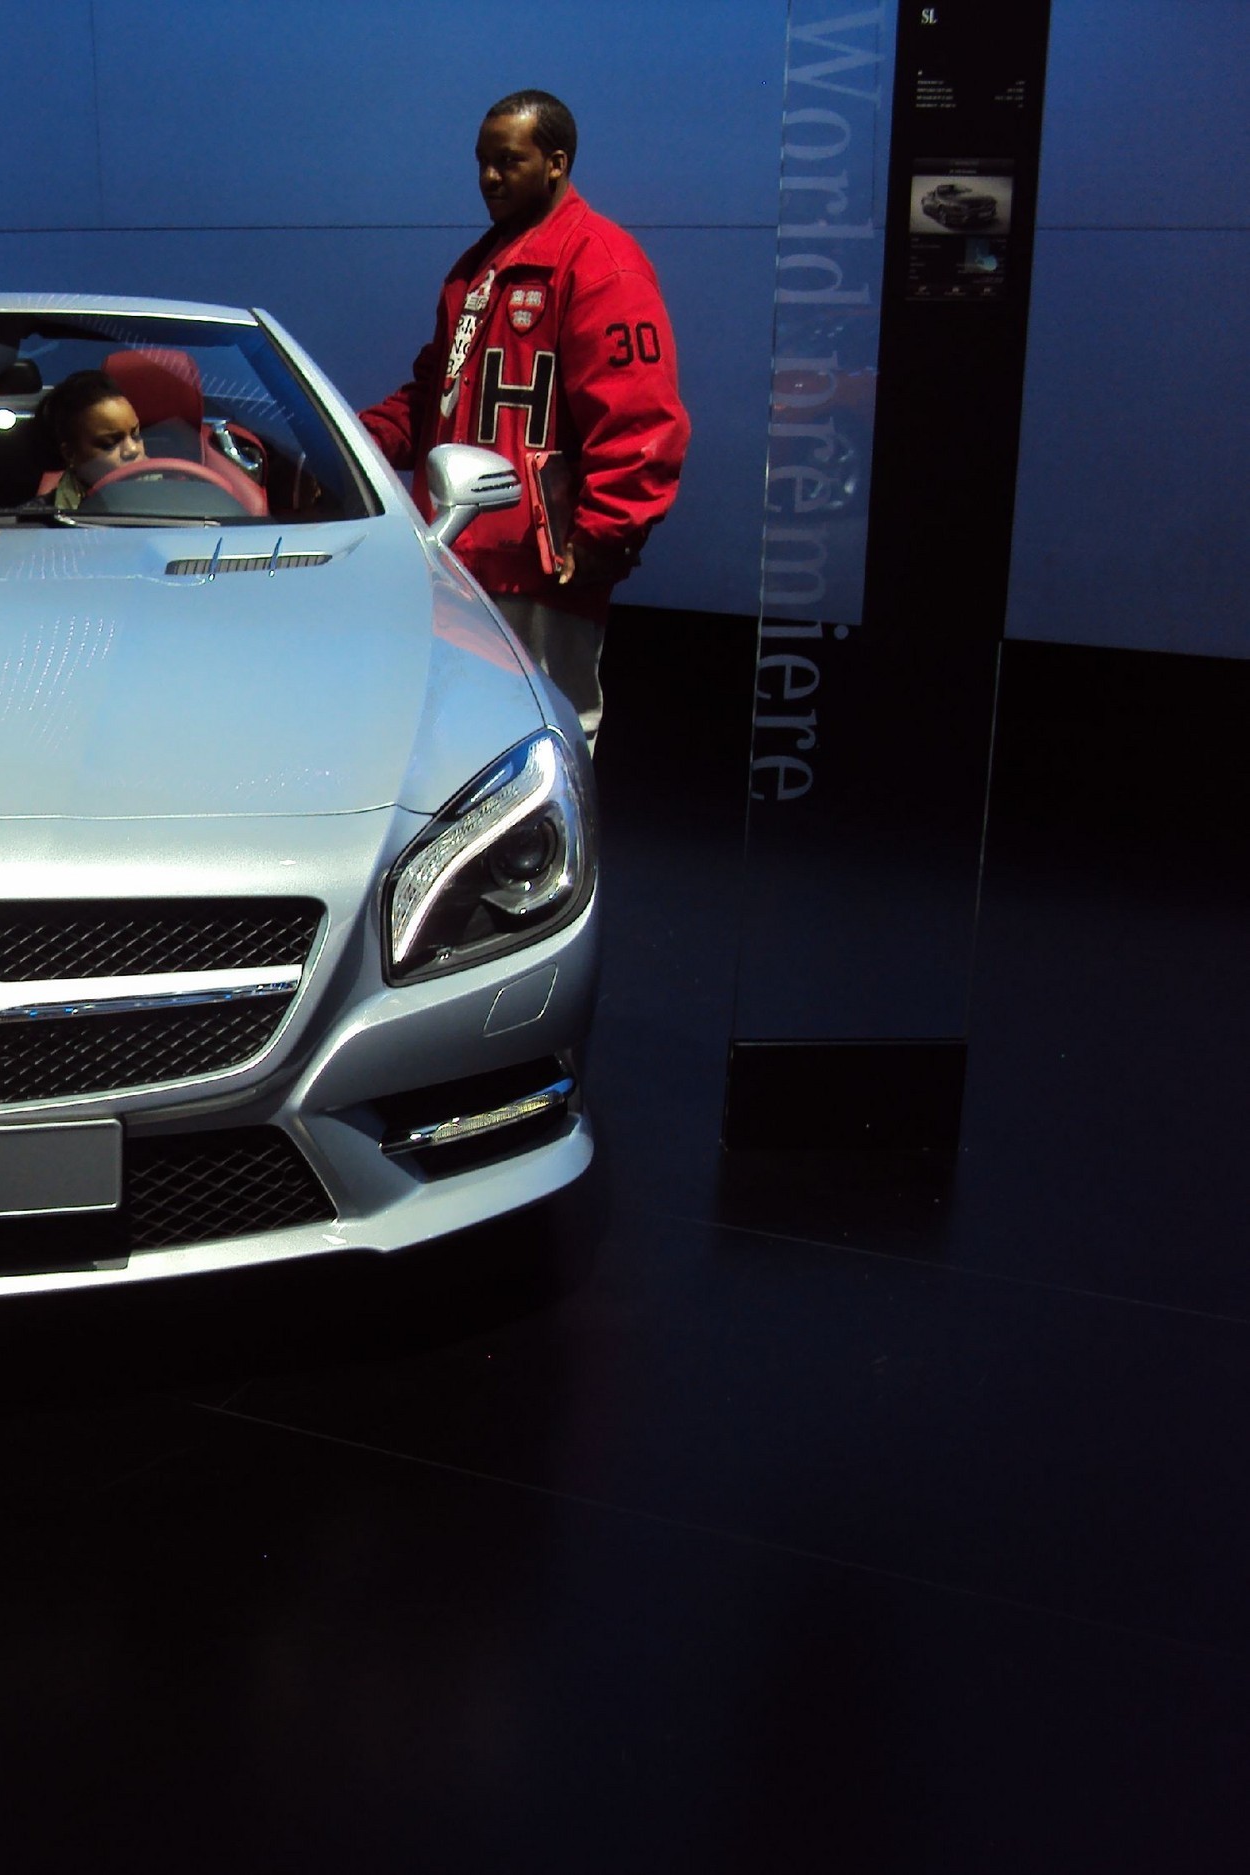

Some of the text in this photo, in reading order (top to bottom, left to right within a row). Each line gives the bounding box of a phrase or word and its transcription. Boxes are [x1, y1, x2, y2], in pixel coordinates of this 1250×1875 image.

[921, 8, 937, 24] SL
[775, 0, 886, 304] World
[605, 322, 661, 366] 30
[477, 346, 555, 448] H
